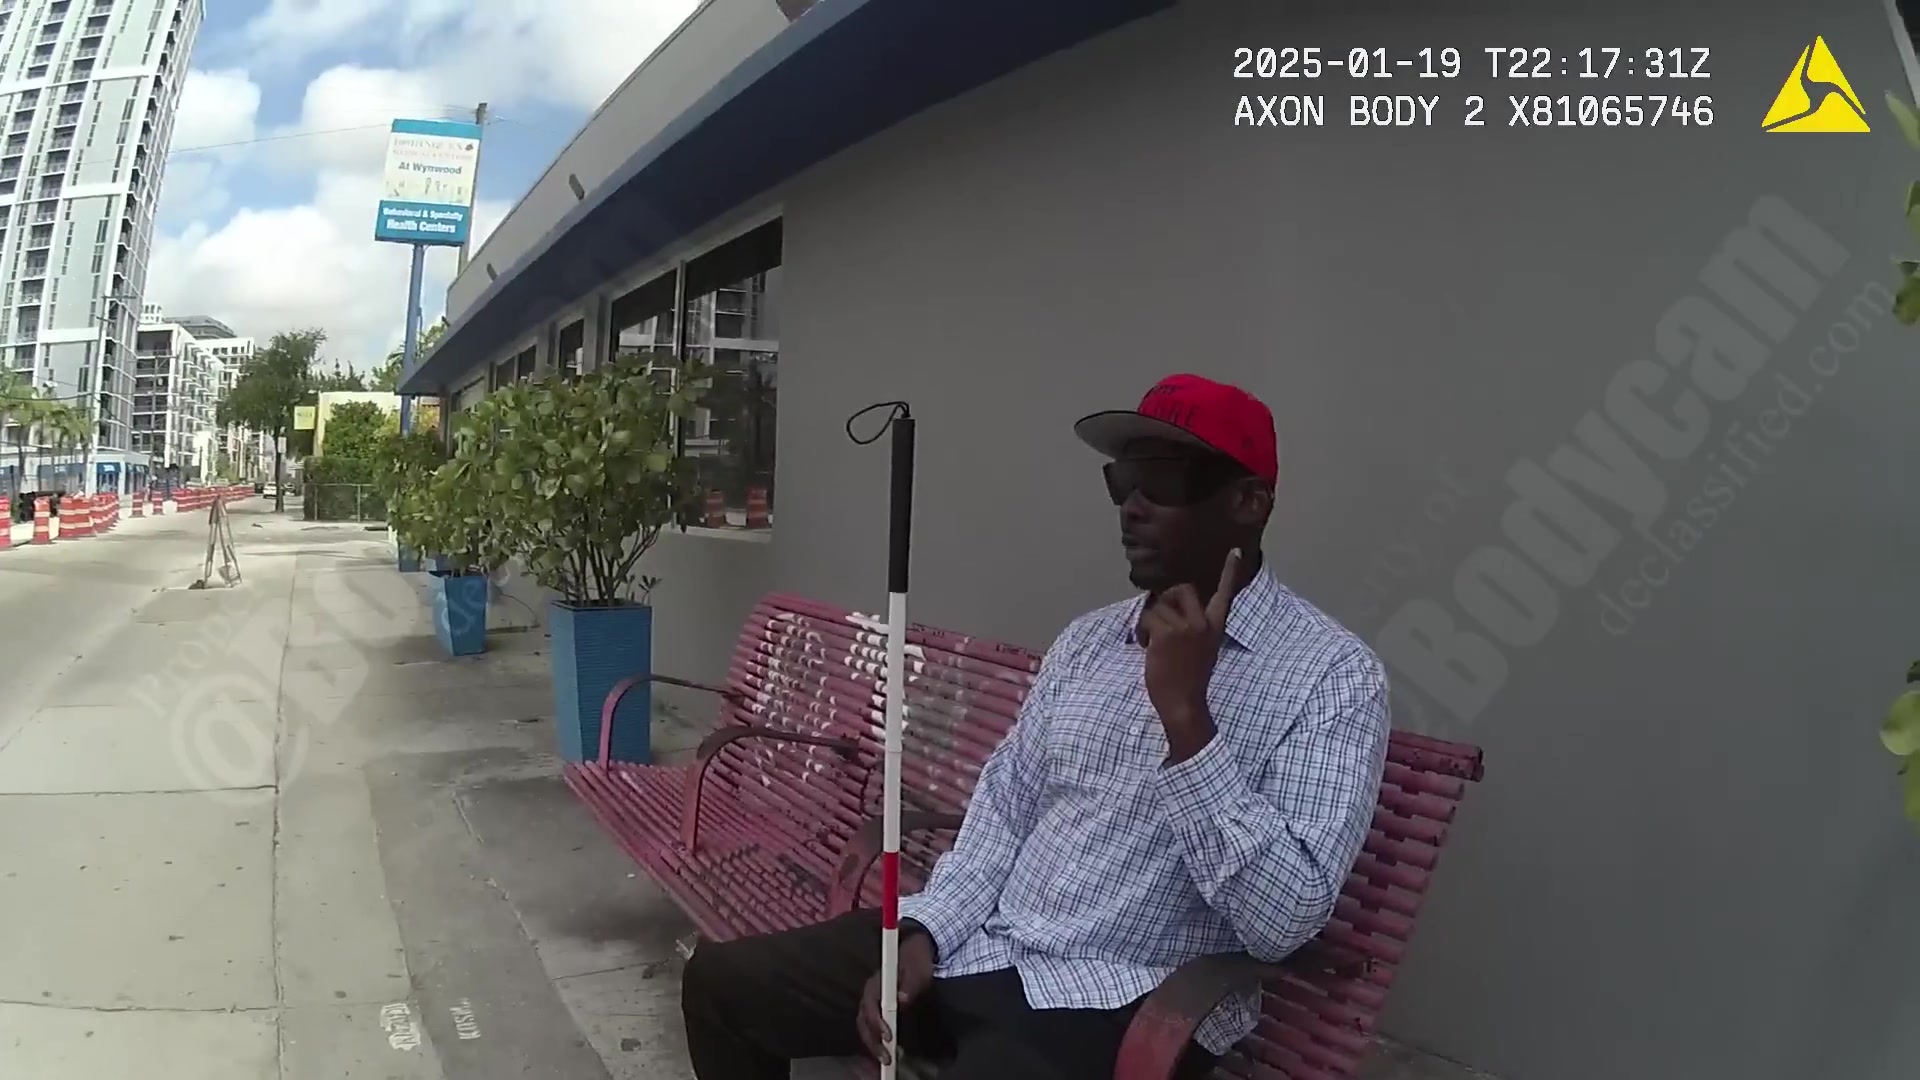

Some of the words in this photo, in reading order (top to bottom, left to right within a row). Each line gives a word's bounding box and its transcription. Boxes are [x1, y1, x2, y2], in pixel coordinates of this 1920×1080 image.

[399, 162, 409, 171] At
[413, 163, 462, 174] Wynwood
[387, 219, 418, 230] Health
